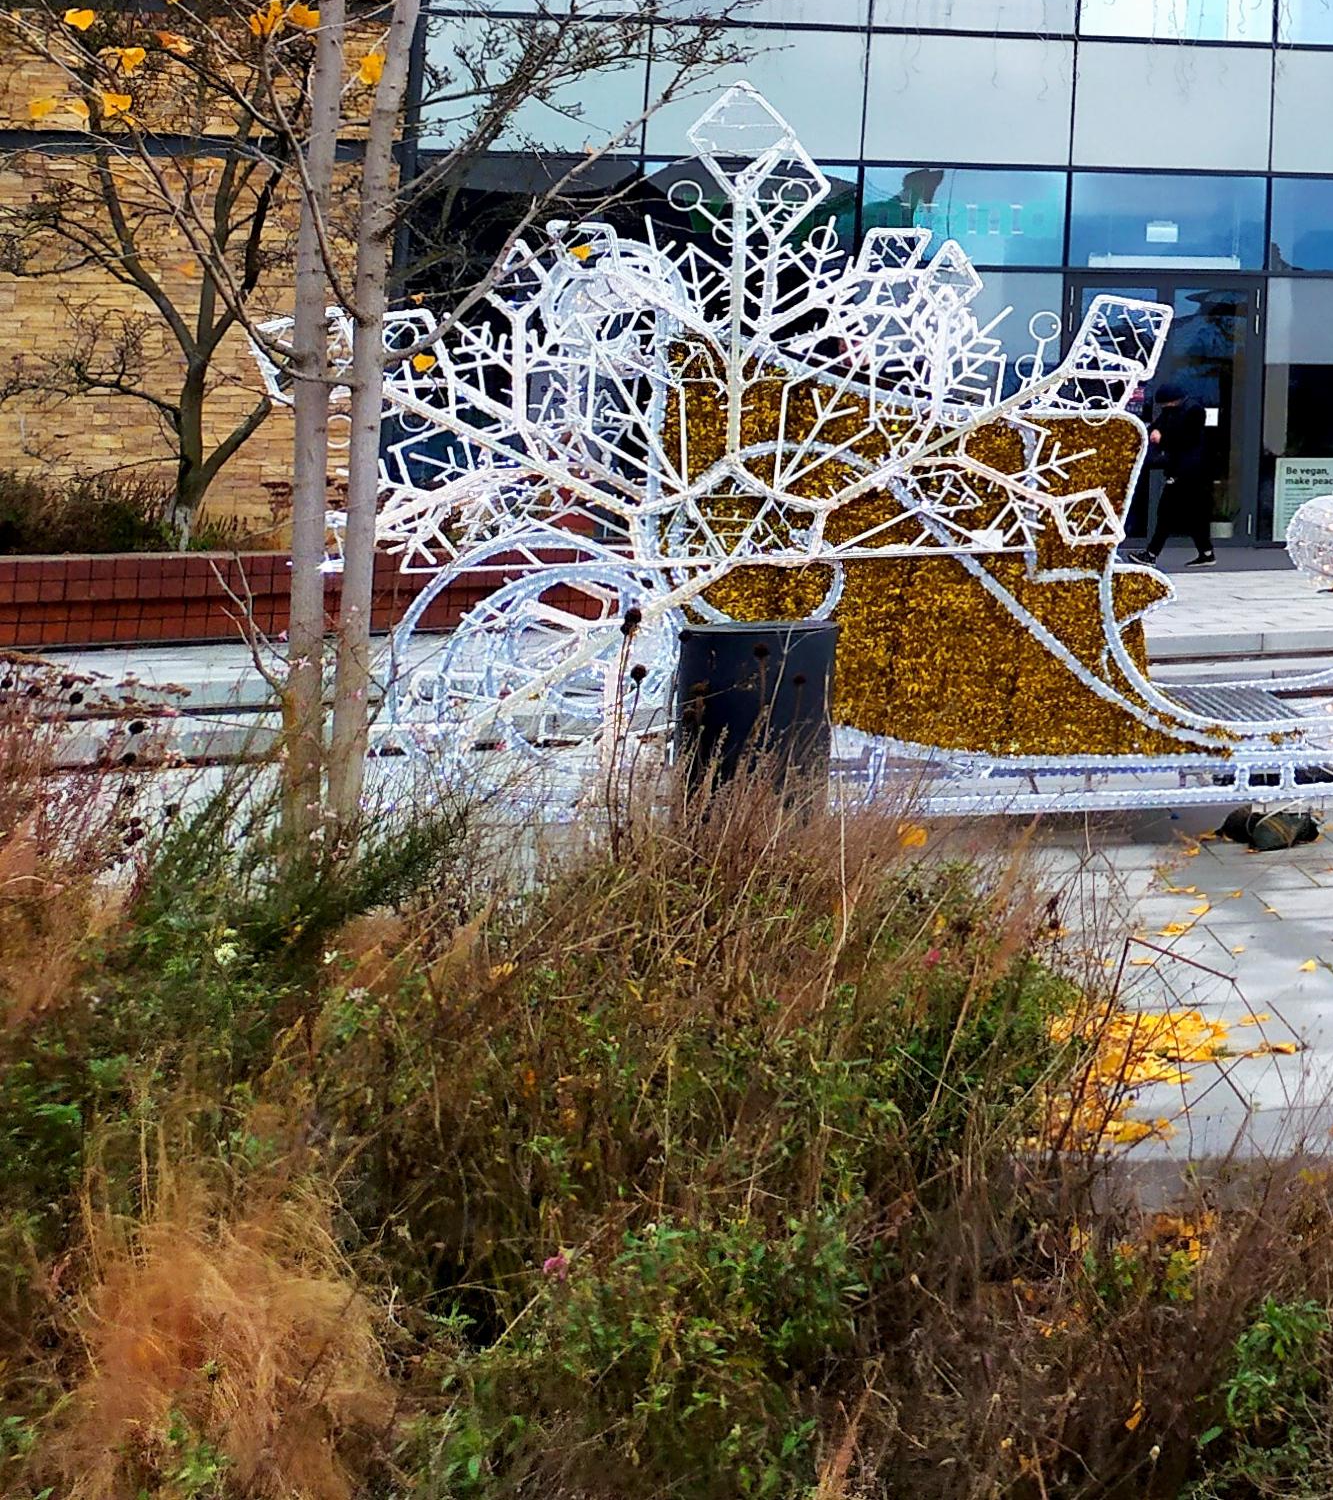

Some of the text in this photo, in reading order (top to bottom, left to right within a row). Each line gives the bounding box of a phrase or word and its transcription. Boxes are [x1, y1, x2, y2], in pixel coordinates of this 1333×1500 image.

[1286, 466, 1329, 476] Be vegan,
[1285, 477, 1310, 485] make
